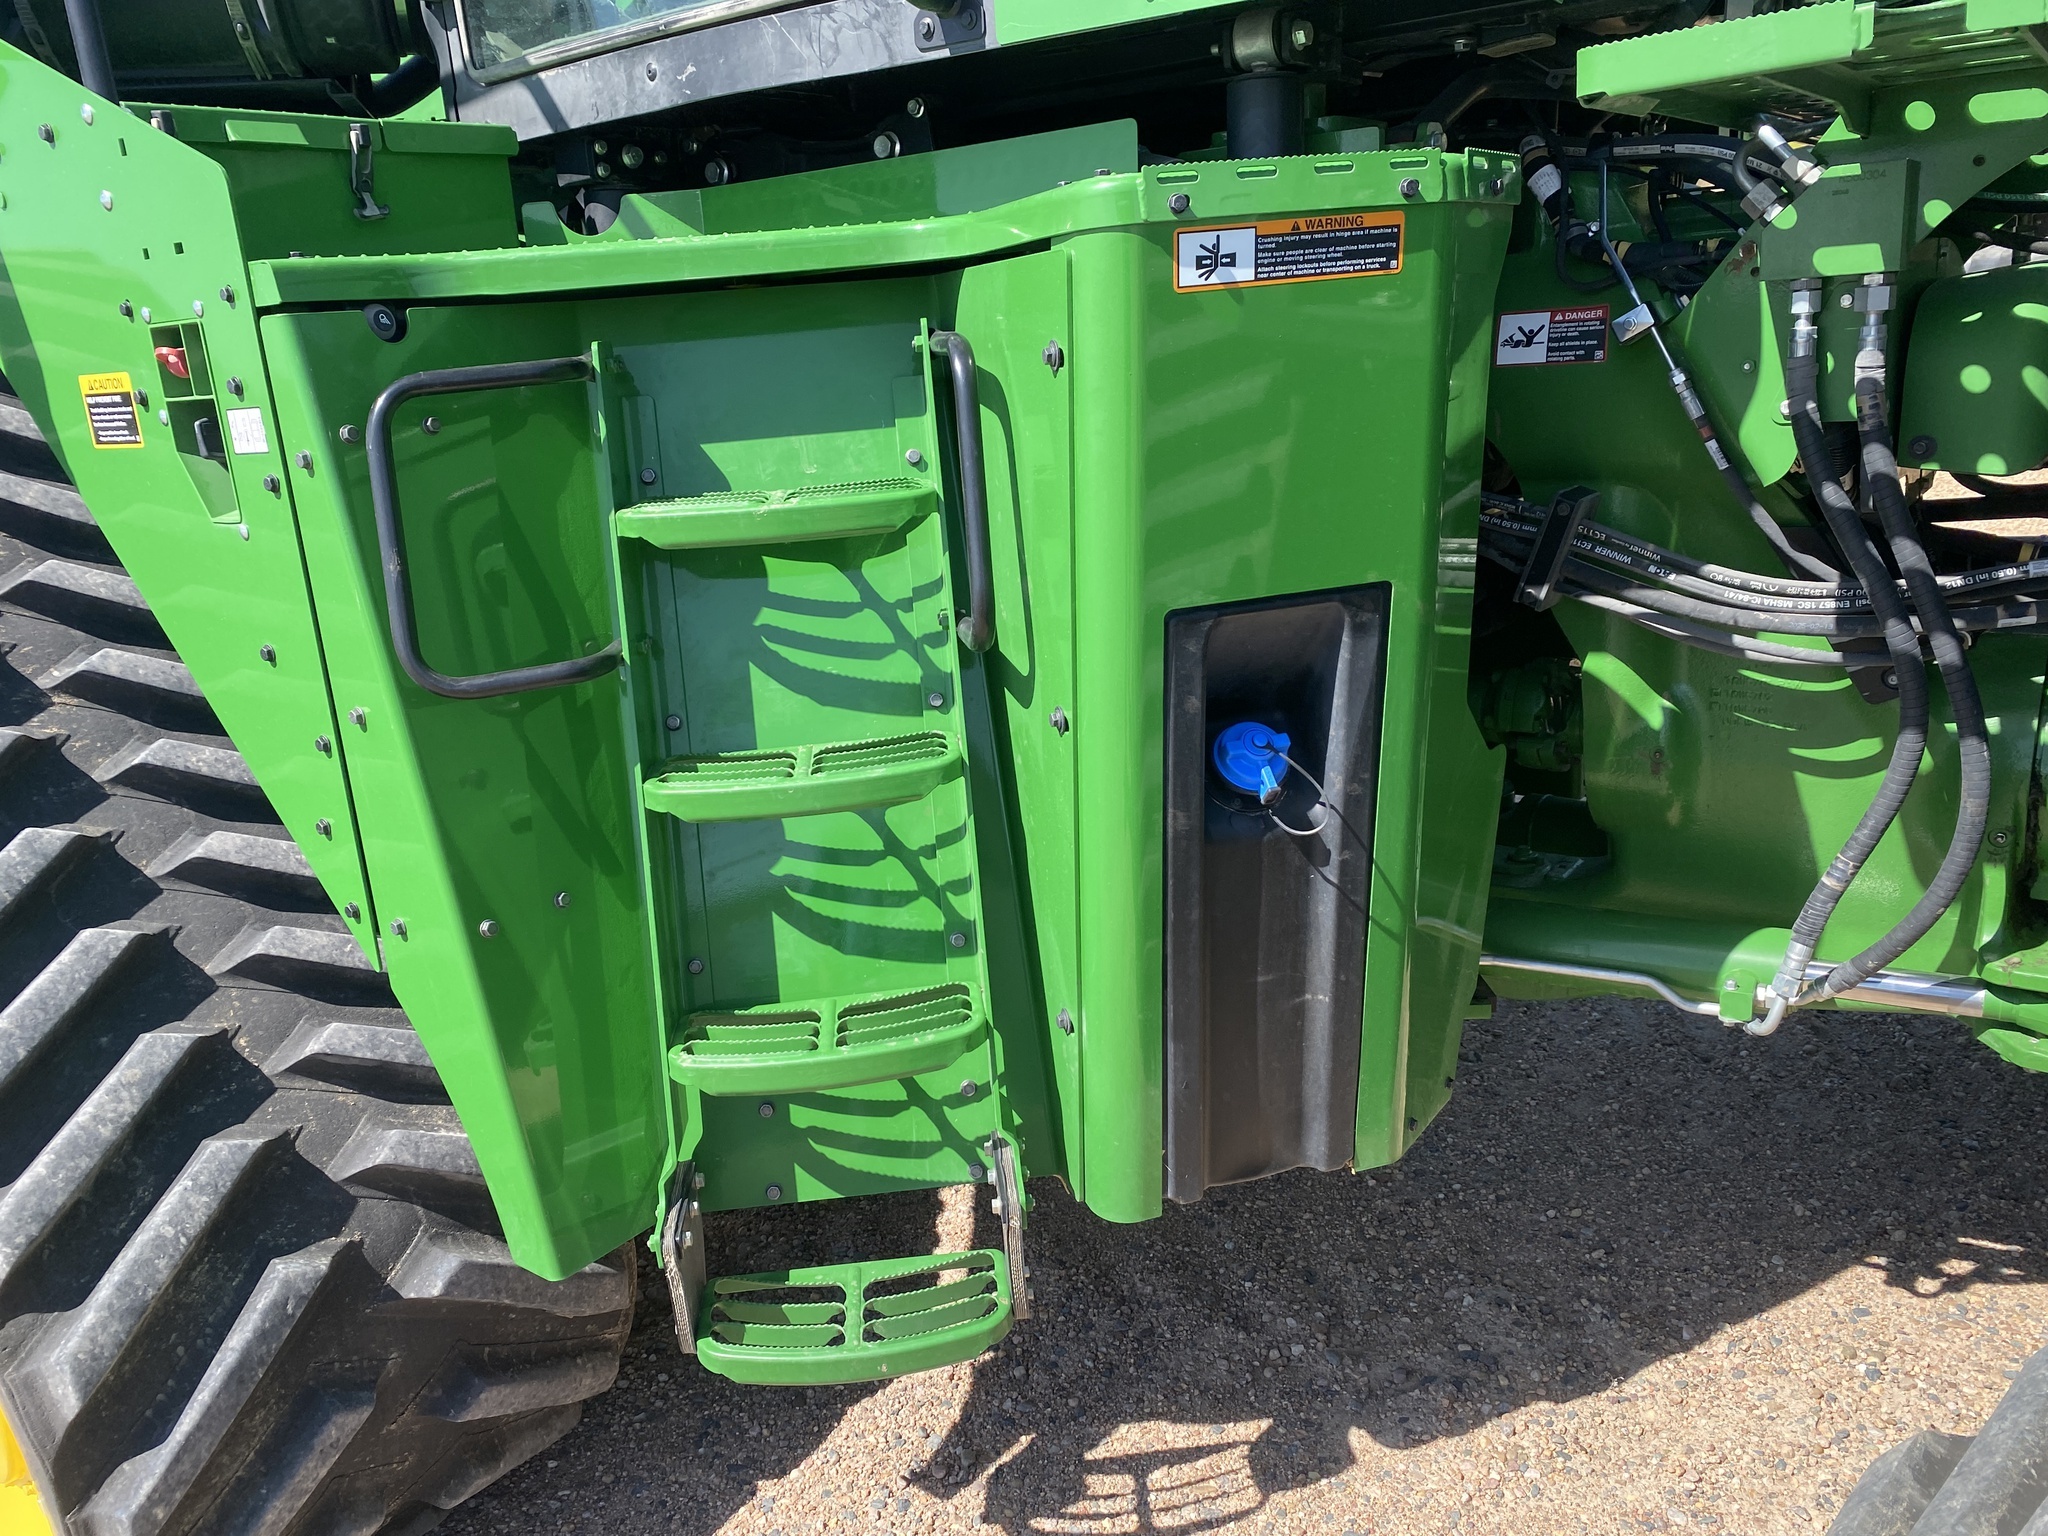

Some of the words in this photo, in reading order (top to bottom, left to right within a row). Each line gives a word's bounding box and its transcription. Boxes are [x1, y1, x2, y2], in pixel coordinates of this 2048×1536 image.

[1305, 215, 1364, 230] WARNING
[1323, 265, 1354, 273] transporting
[1565, 310, 1603, 319] DANGER
[93, 378, 124, 390] CAUTION
[1490, 516, 1501, 525] in)
[1502, 519, 1520, 530] (0.50
[1577, 525, 1606, 541] EC115
[1630, 545, 1661, 562] Winner
[1571, 539, 1592, 550] EC11
[1595, 545, 1632, 565] WINNER
[1992, 567, 2017, 579] (0.50
[1945, 577, 1973, 590] DN12
[1976, 575, 1989, 583] in)
[1724, 590, 1760, 605] IC-84/41
[1835, 589, 1853, 597] PSI)
[1764, 599, 1793, 608] MSHA
[1798, 600, 1816, 609] 1SC
[1819, 600, 1850, 608] EN857
